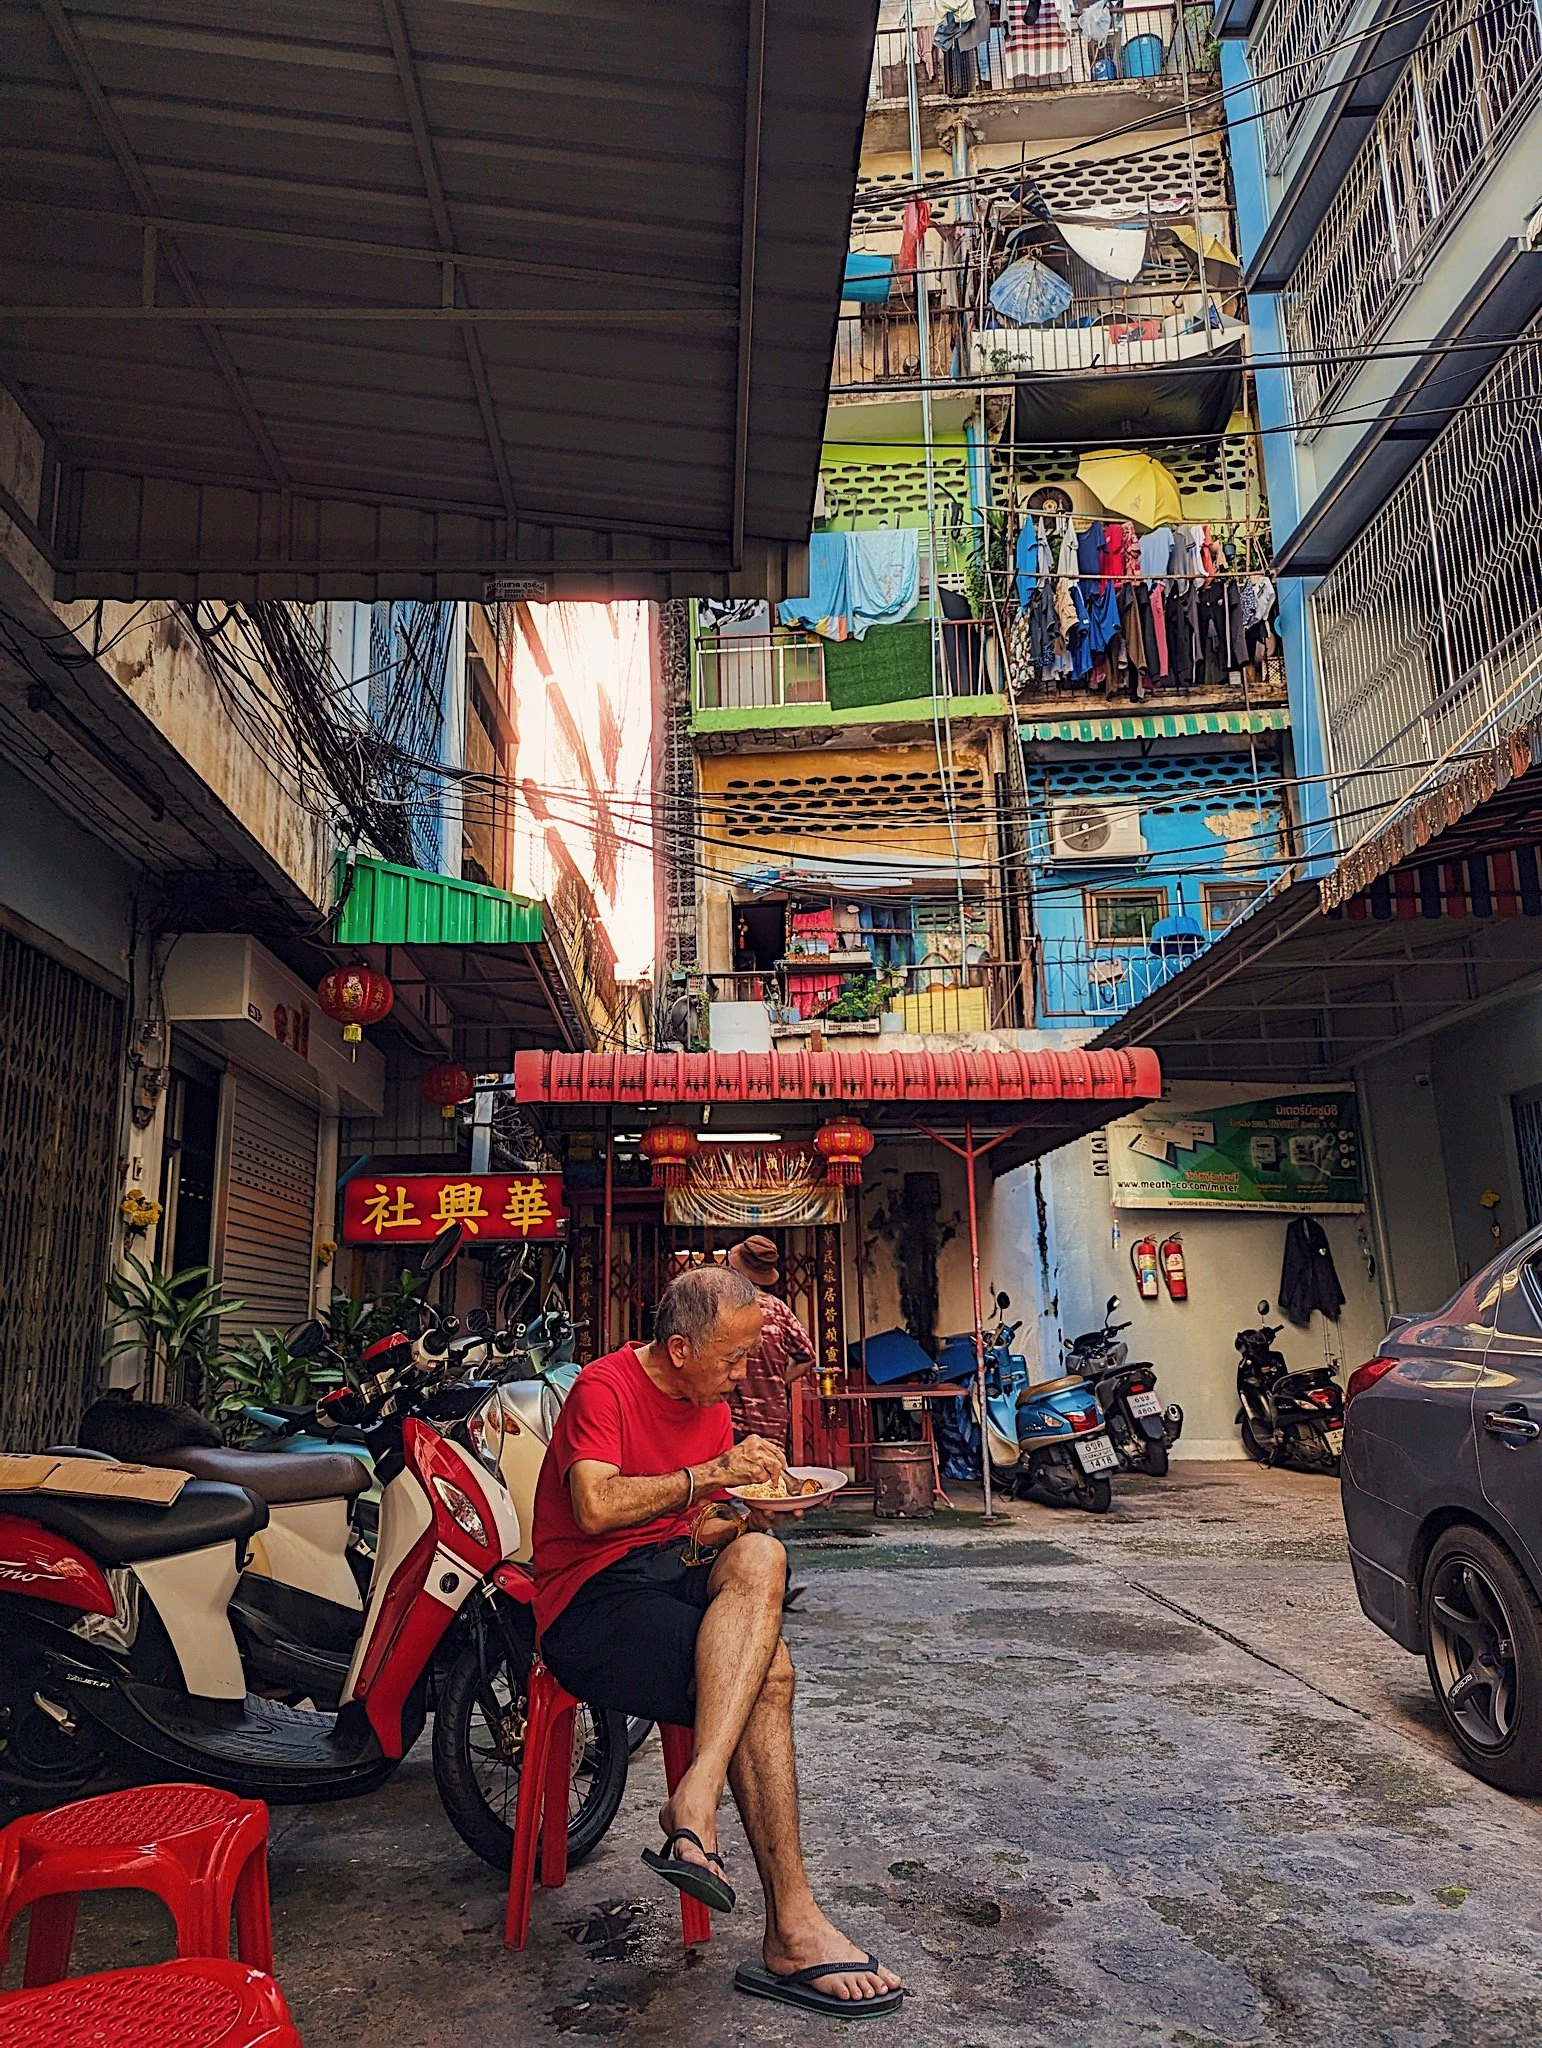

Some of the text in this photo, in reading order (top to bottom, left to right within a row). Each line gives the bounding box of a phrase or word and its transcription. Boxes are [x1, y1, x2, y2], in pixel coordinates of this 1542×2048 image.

[1117, 1180, 1238, 1192] www.meath-co.com/meter
[1138, 1406, 1157, 1415] 4801
[1090, 1456, 1113, 1469] 1418
